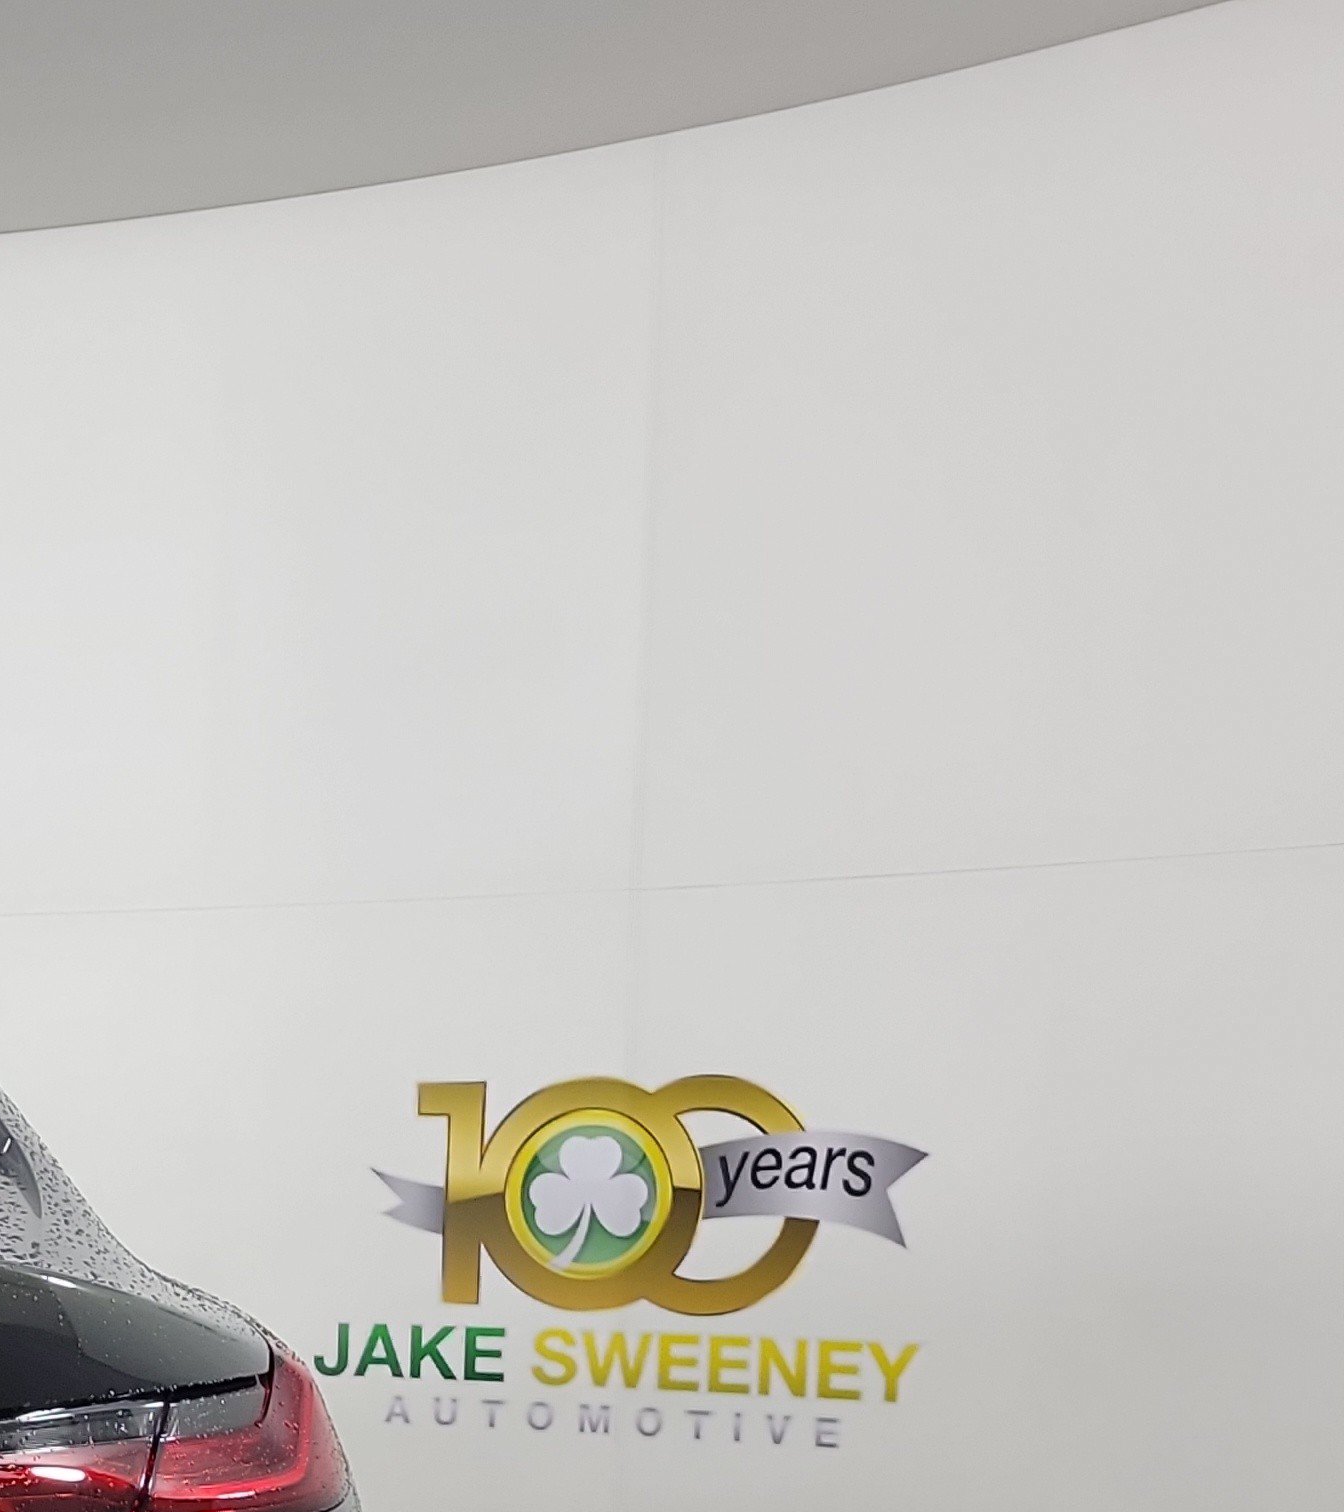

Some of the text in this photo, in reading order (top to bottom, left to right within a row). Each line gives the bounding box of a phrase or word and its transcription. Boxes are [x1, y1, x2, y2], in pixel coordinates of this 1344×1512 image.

[417, 1074, 875, 1316] 100 years
[314, 1322, 919, 1402] JAKE SWEENEY
[385, 1395, 839, 1448] AUTOMOTIVE
